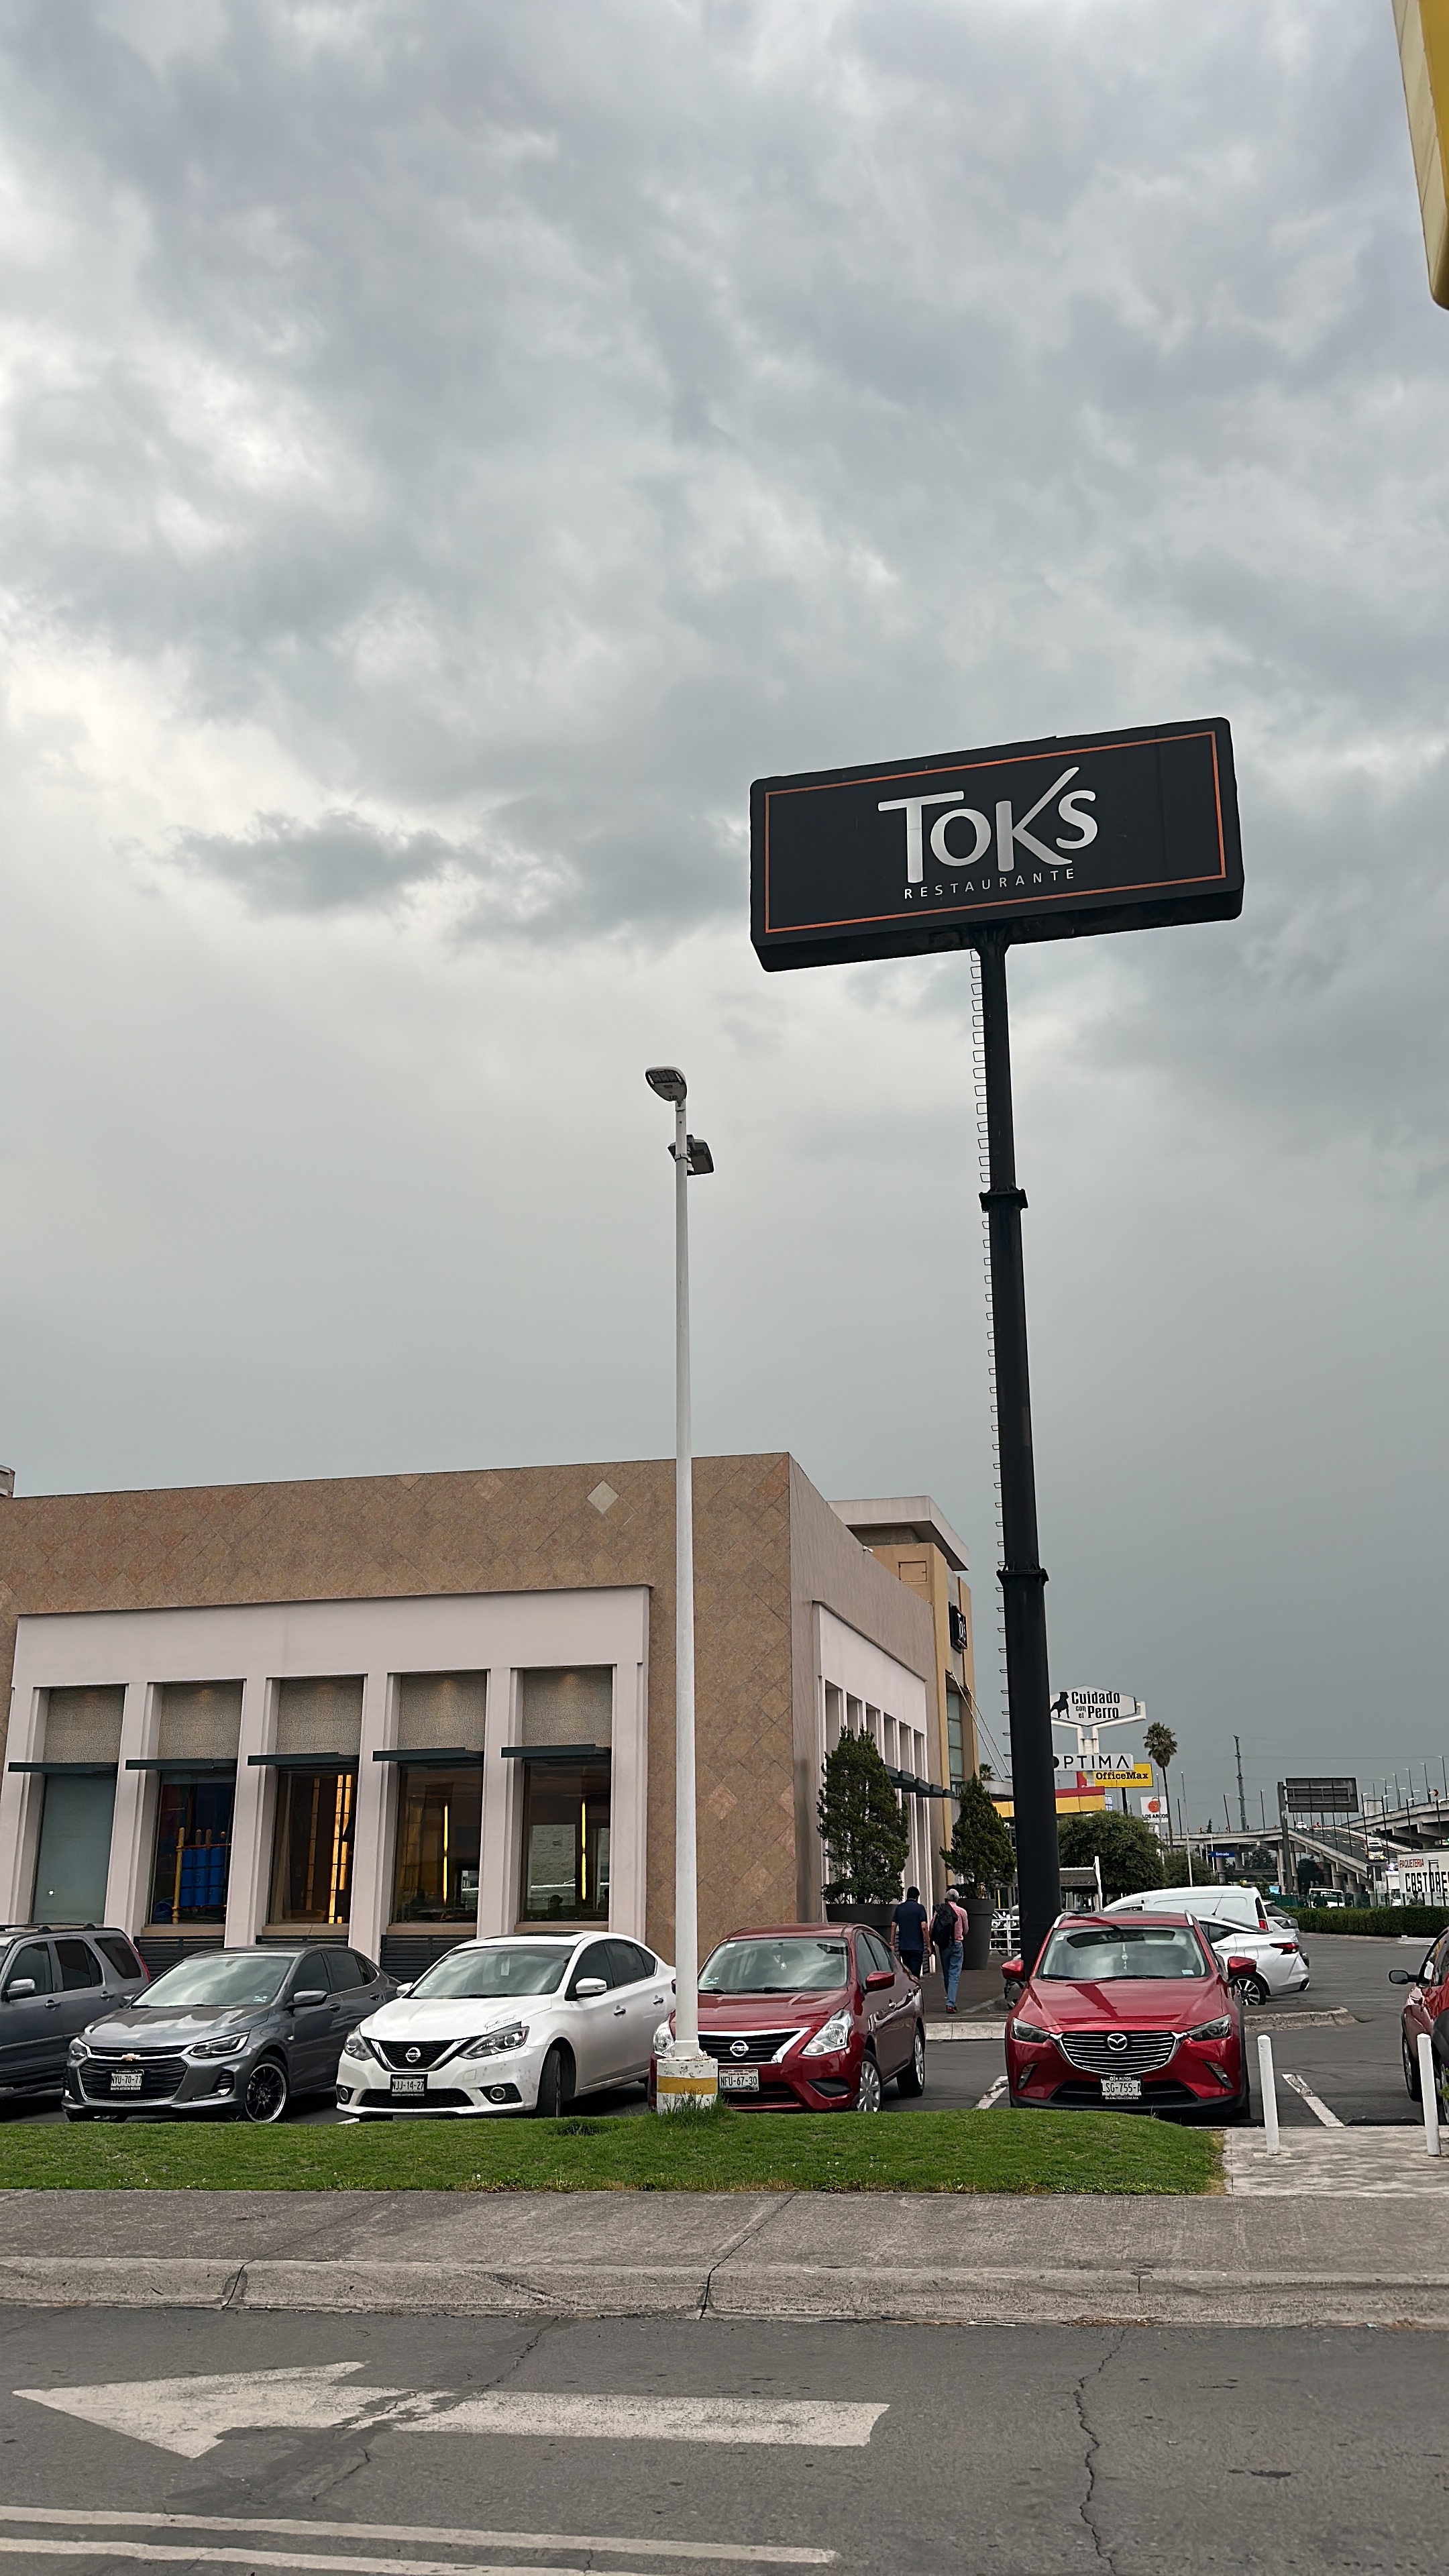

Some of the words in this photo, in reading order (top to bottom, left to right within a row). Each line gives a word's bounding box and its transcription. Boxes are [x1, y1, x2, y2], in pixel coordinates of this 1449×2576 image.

[904, 868, 1075, 900] RESTAURANTE
[1071, 1691, 1120, 1705] Cuidado
[1087, 1705, 1119, 1719] Perro
[1095, 1772, 1148, 1780] OfficeMax
[1405, 1871, 1449, 1892] CASTORE
[720, 2076, 757, 2086] NFU-67-30
